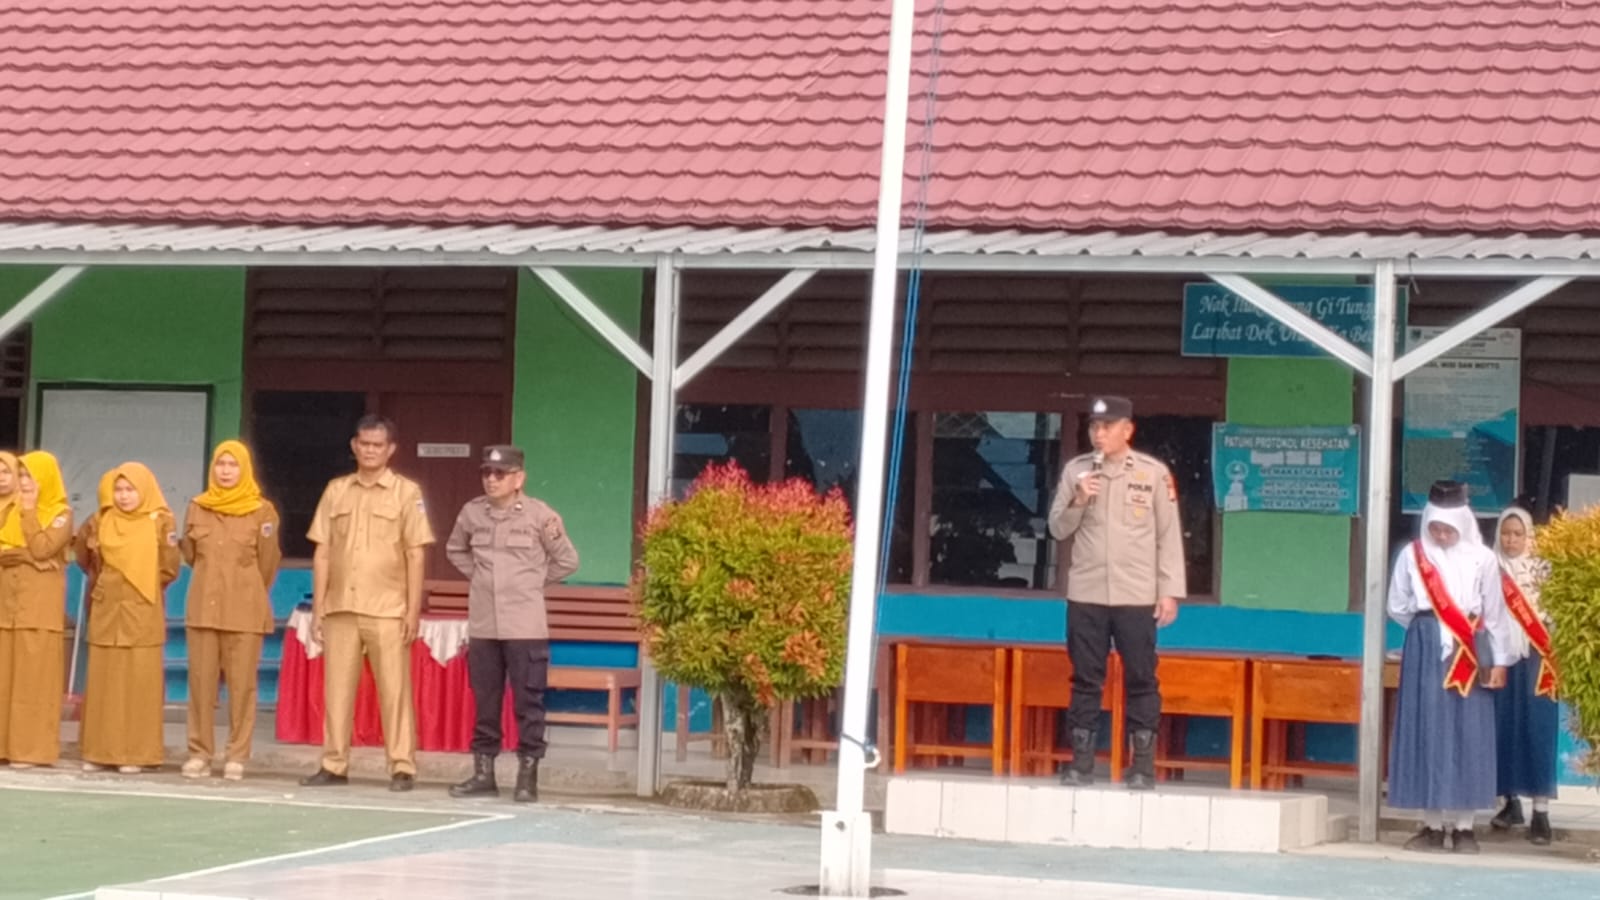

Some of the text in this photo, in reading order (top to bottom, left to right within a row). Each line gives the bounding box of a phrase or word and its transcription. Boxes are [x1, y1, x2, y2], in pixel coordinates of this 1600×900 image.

[1199, 294, 1232, 318] Nak
[1316, 297, 1334, 321] Gi
[1246, 322, 1278, 346] Dek
[1255, 436, 1298, 449] PROTOKOL
[1301, 437, 1350, 450] KESEHATAN
